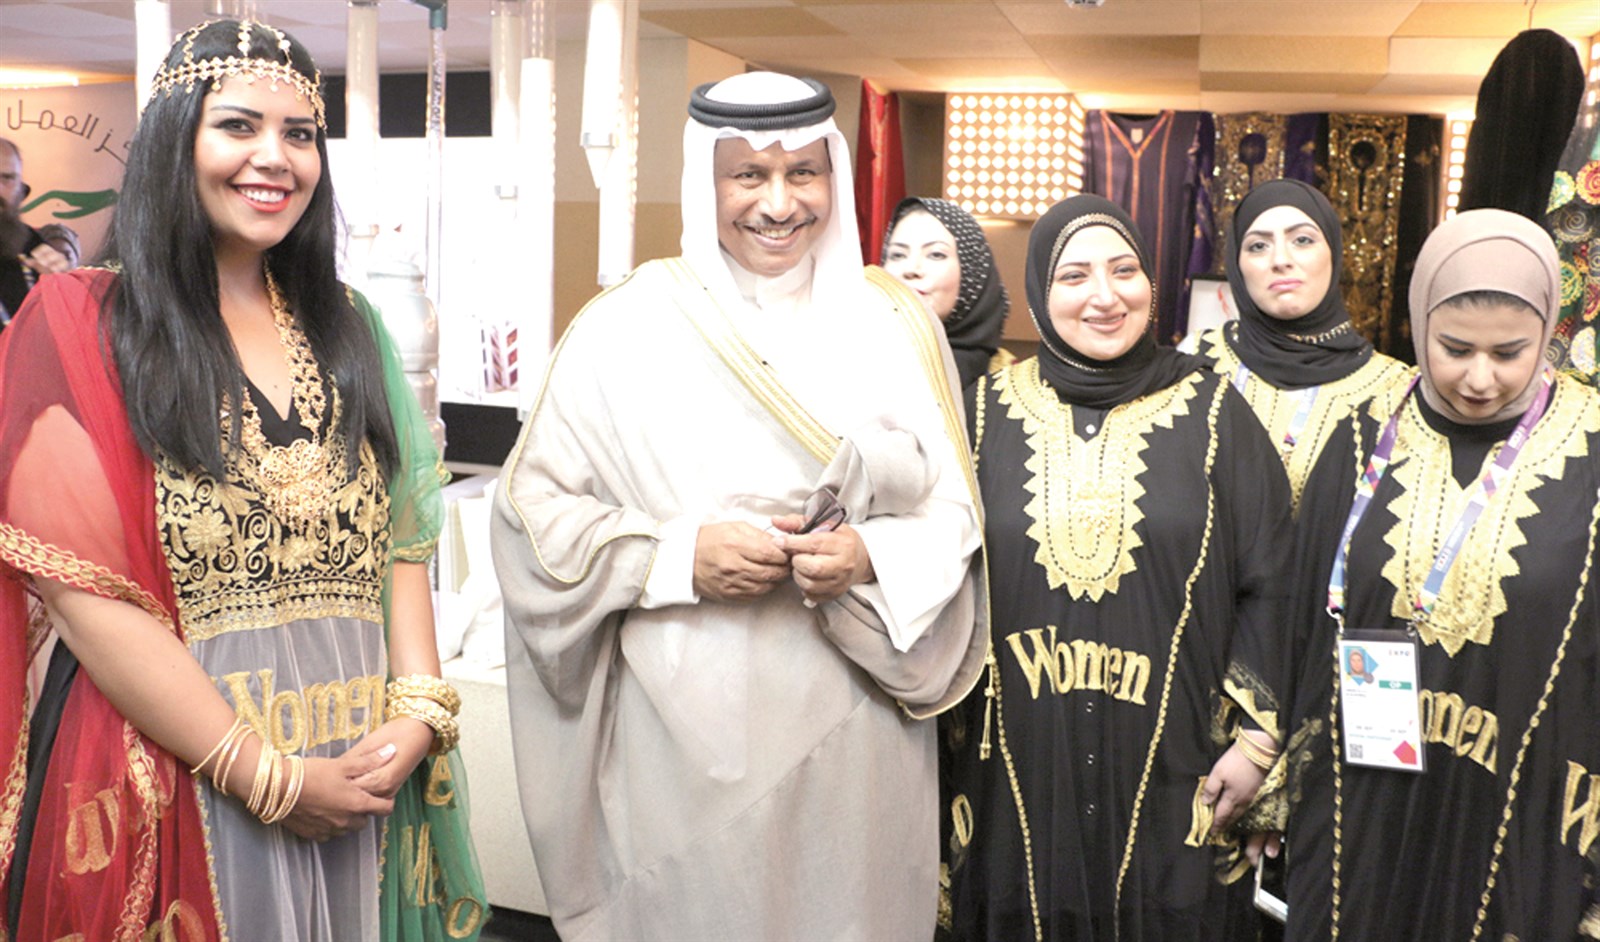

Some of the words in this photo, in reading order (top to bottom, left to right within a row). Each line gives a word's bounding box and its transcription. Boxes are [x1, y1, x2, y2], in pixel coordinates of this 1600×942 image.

[7, 99, 100, 140] العمل
[1005, 625, 1151, 706] Women
[1418, 688, 1499, 775] omen
